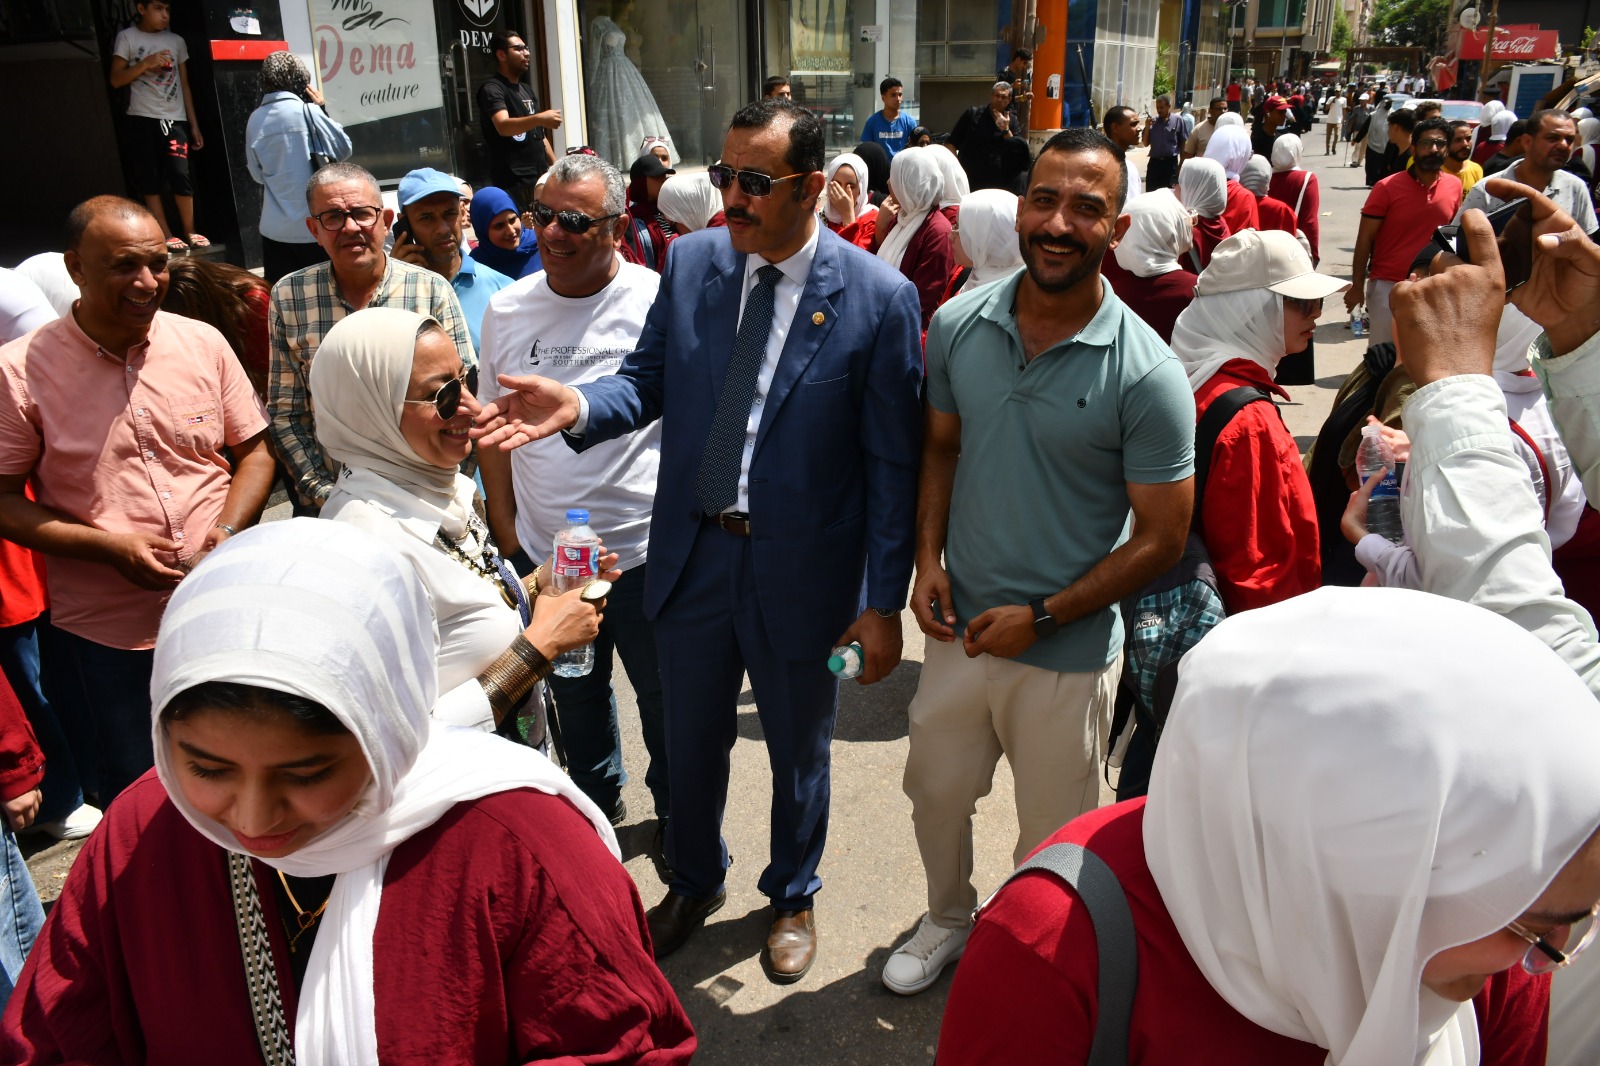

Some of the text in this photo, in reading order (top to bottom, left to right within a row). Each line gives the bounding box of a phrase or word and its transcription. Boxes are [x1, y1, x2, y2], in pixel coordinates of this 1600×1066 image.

[315, 24, 416, 83] Dema
[360, 82, 420, 107] couture
[550, 345, 613, 355] PROFESSIONAL
